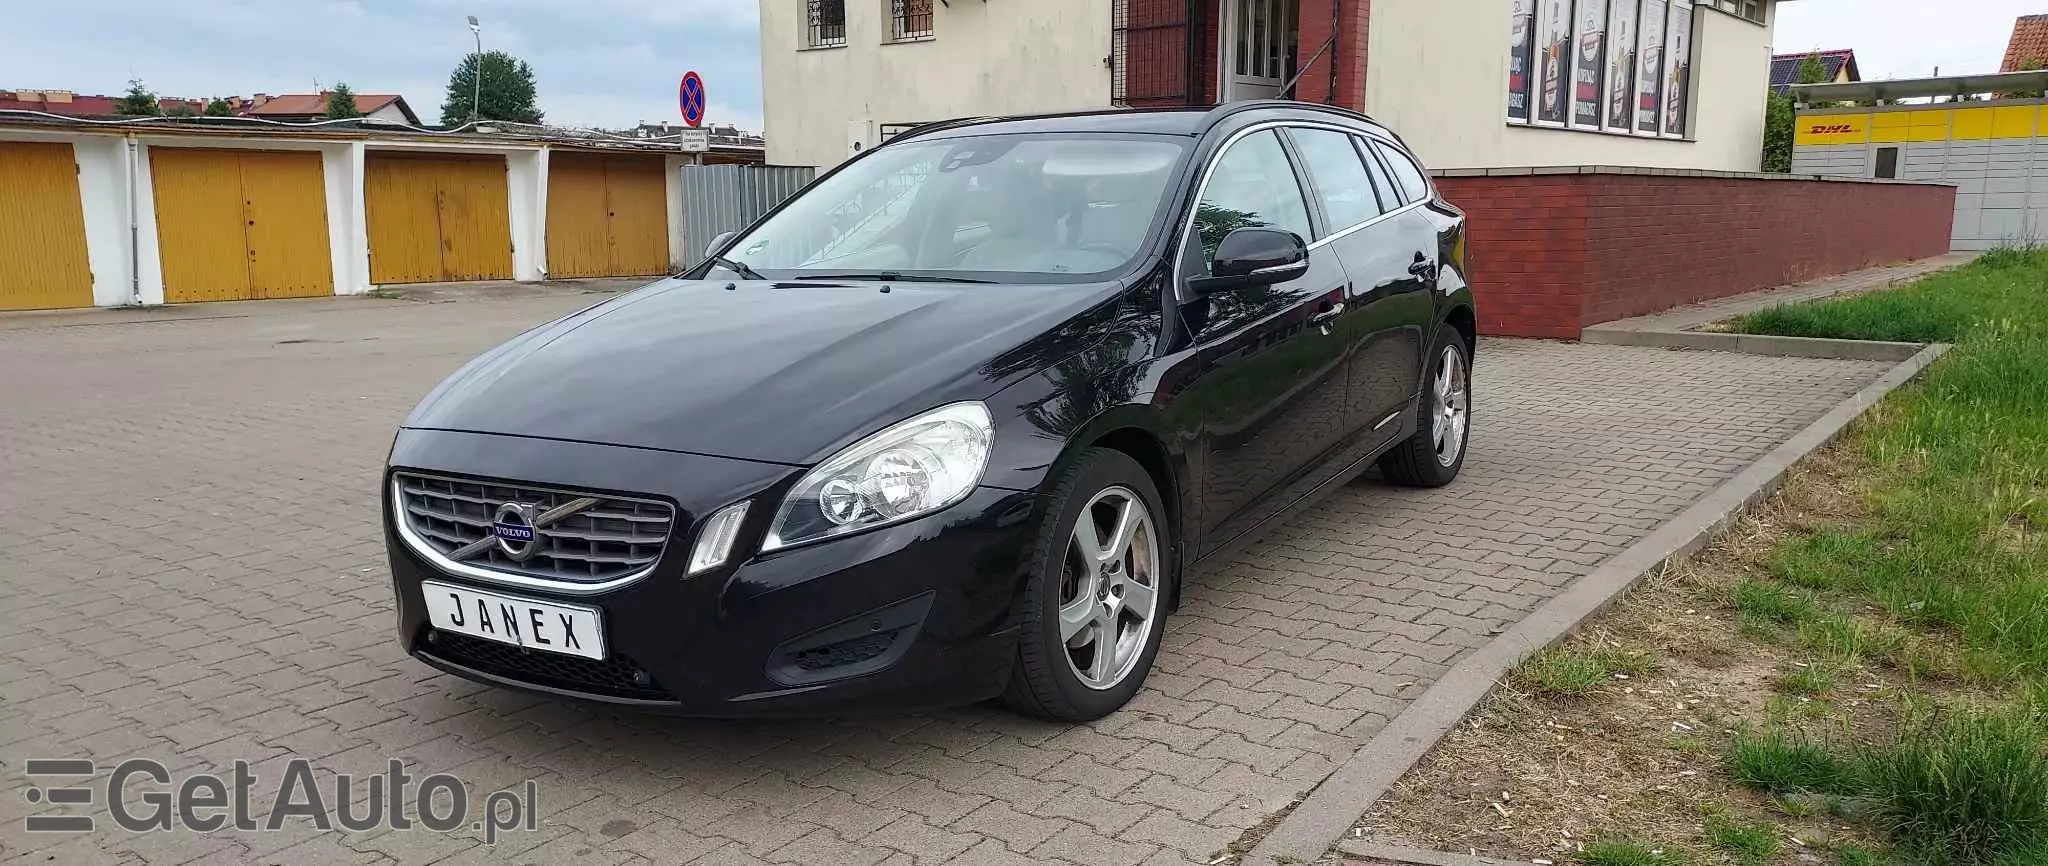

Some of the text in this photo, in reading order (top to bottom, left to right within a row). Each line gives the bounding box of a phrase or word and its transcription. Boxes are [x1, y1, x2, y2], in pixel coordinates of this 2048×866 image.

[1810, 124, 1851, 134] DHL
[495, 526, 531, 538] VOLVO
[449, 593, 581, 650] JANEX
